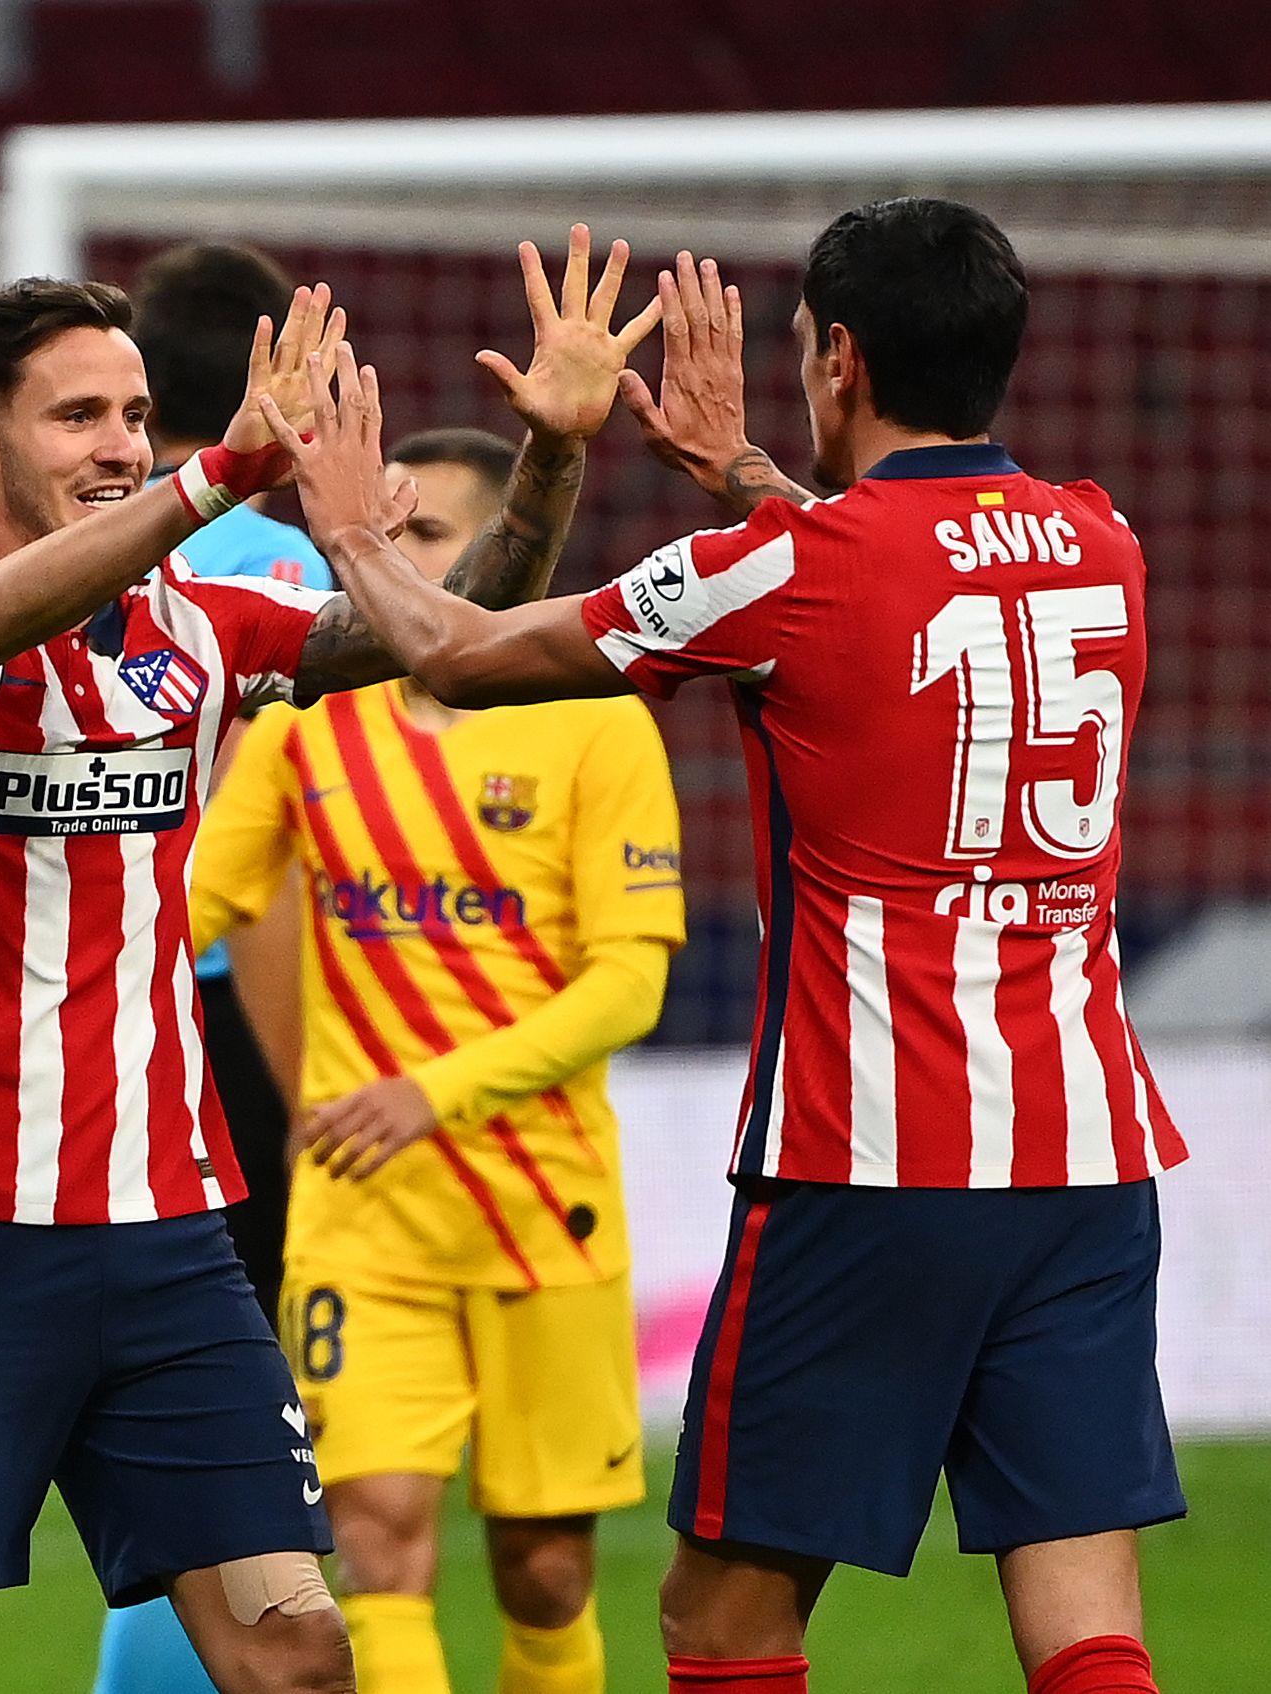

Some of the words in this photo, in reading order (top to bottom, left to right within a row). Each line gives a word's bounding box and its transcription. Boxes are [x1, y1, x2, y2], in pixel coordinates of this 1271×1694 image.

[934, 510, 1082, 573] SAVIĆ
[910, 584, 1129, 860] 15
[51, 818, 87, 834] Trade
[91, 817, 139, 832] Online
[933, 865, 1029, 925] ria
[1038, 881, 1095, 902] Money
